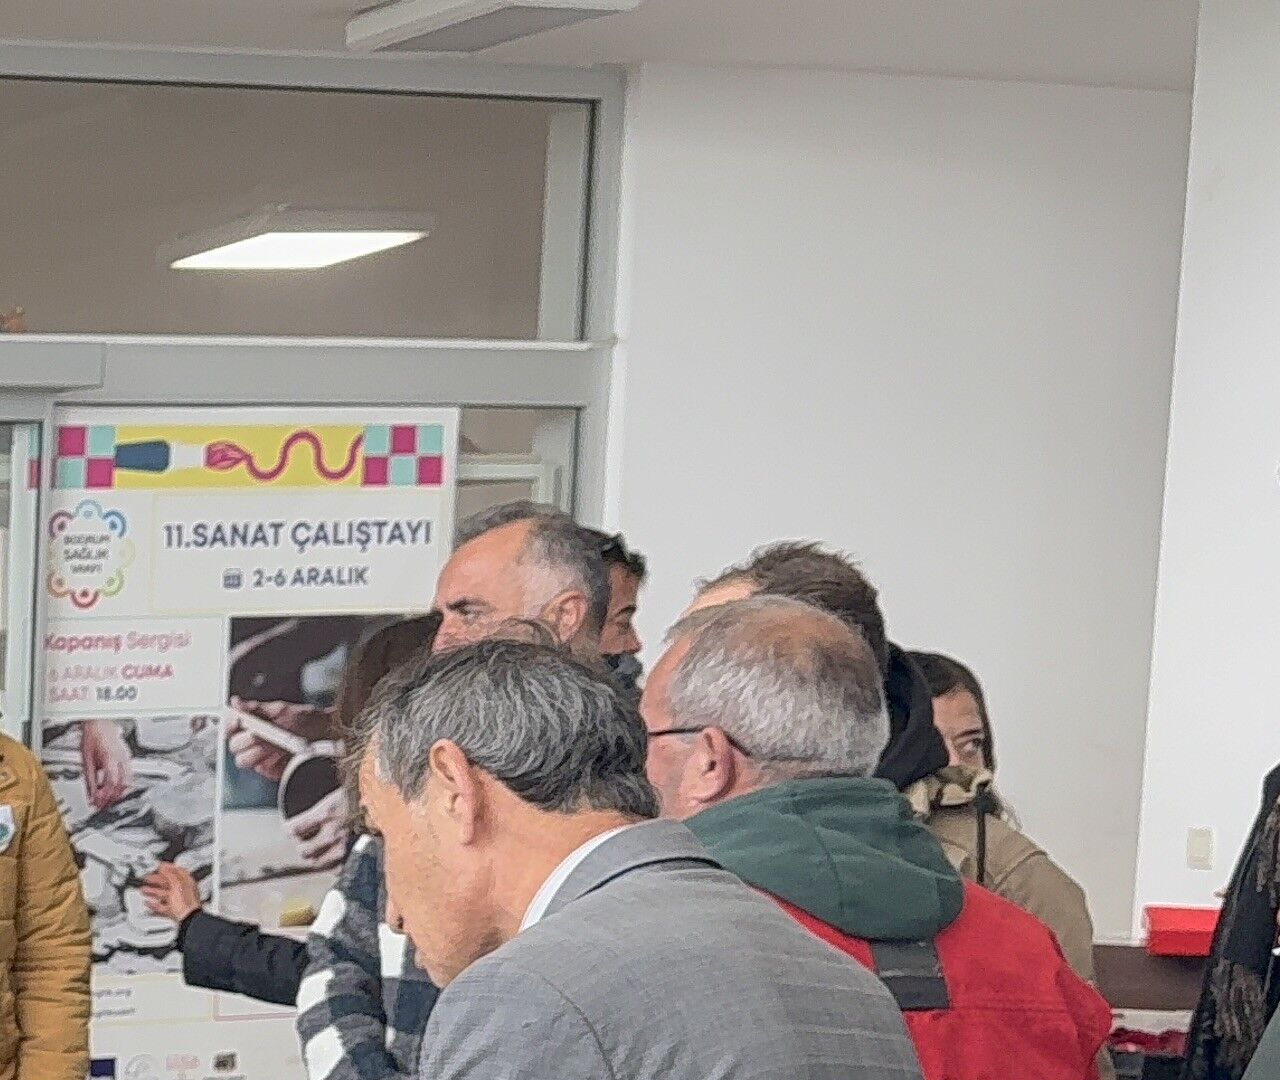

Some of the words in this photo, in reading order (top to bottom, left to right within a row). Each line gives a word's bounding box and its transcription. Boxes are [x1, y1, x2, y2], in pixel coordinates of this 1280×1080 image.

[163, 522, 286, 548] 11.SANAT
[291, 520, 432, 553] ÇALIŞTAYI
[252, 568, 287, 588] 2-6
[291, 566, 370, 586] ARALIK
[121, 664, 175, 680] CUMA
